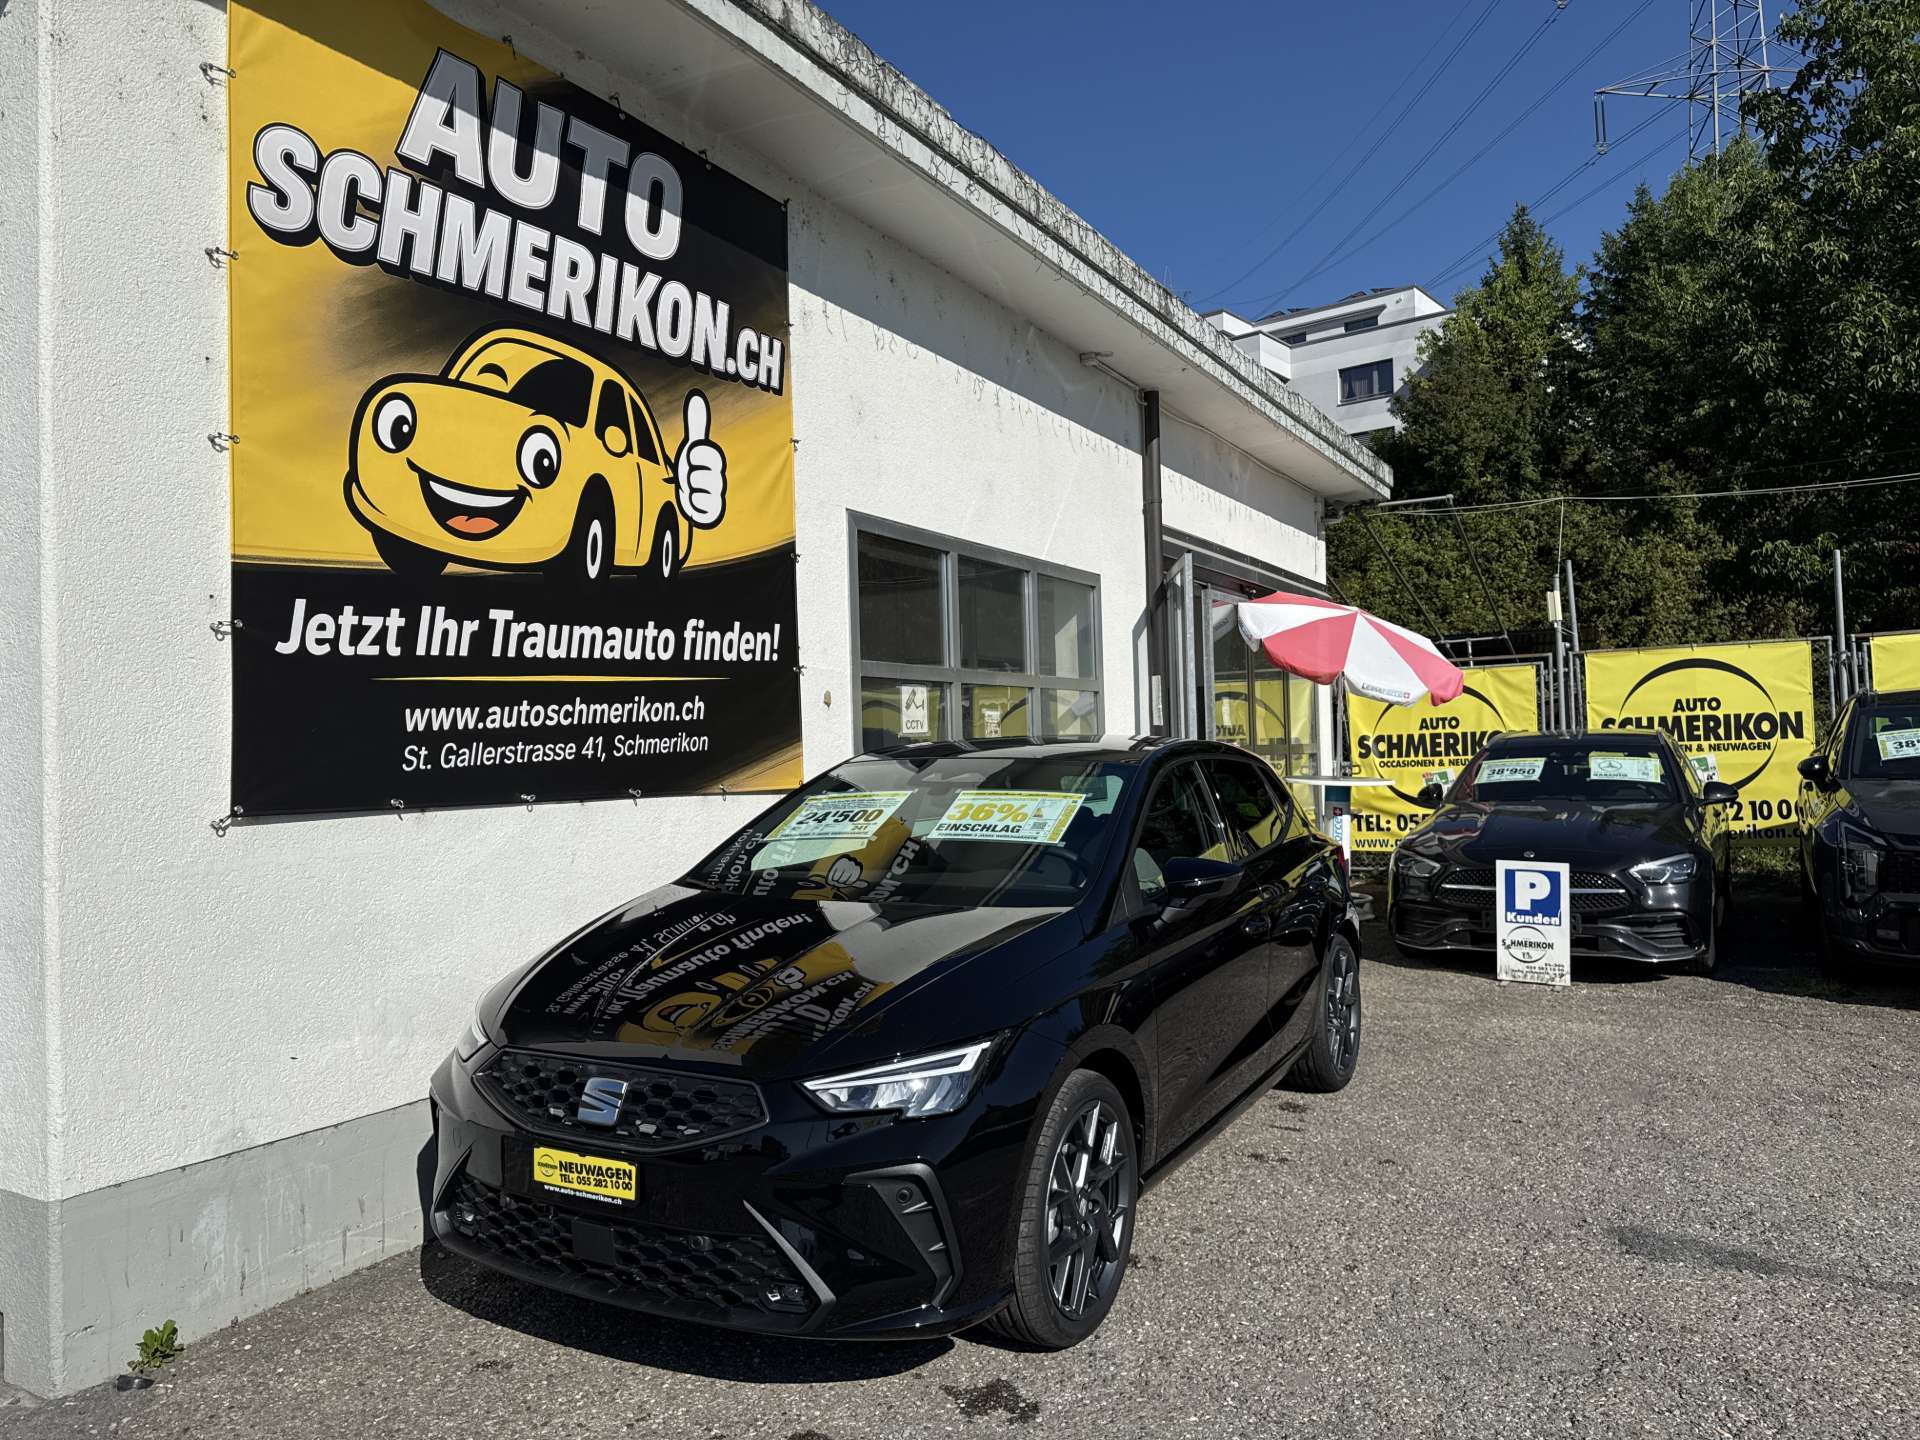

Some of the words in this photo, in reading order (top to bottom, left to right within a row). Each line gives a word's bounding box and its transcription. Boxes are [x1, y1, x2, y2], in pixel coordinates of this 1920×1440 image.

[398, 49, 683, 261] AUTO
[250, 125, 782, 393] SCHMERIKON.CH
[275, 598, 405, 656] Jetzt
[416, 605, 479, 657] Ihr
[489, 609, 675, 660] Traumauto
[683, 618, 780, 661] finden!
[1674, 697, 1721, 712] AUTO
[405, 696, 705, 732] www.autoschmerikon.ch
[905, 719, 924, 730] CCTV
[1419, 717, 1460, 730] AUTO
[402, 745, 432, 772] St.
[440, 740, 576, 769] Gallerstrasse
[582, 736, 606, 763] 41,
[613, 732, 709, 757] Schmerikon
[1708, 742, 1771, 752] NEUWAGEN
[1379, 760, 1435, 768] OCCASIONEN
[1488, 768, 1536, 776] 38'950
[796, 809, 884, 825] 24'500
[946, 802, 1029, 823] 36%
[1749, 800, 1773, 820] 10
[935, 823, 1023, 834] EINSCHLAG
[1352, 814, 1391, 832] TEL:
[1515, 871, 1551, 910] P
[1507, 912, 1560, 926] Kunden
[1502, 939, 1554, 950] SHMERIKON
[559, 1160, 632, 1181] NEUWAGEN
[560, 1174, 574, 1184] TEL:
[577, 1176, 591, 1186] 055
[594, 1178, 608, 1188] 282
[611, 1180, 620, 1190] 10
[622, 1181, 632, 1191] 00
